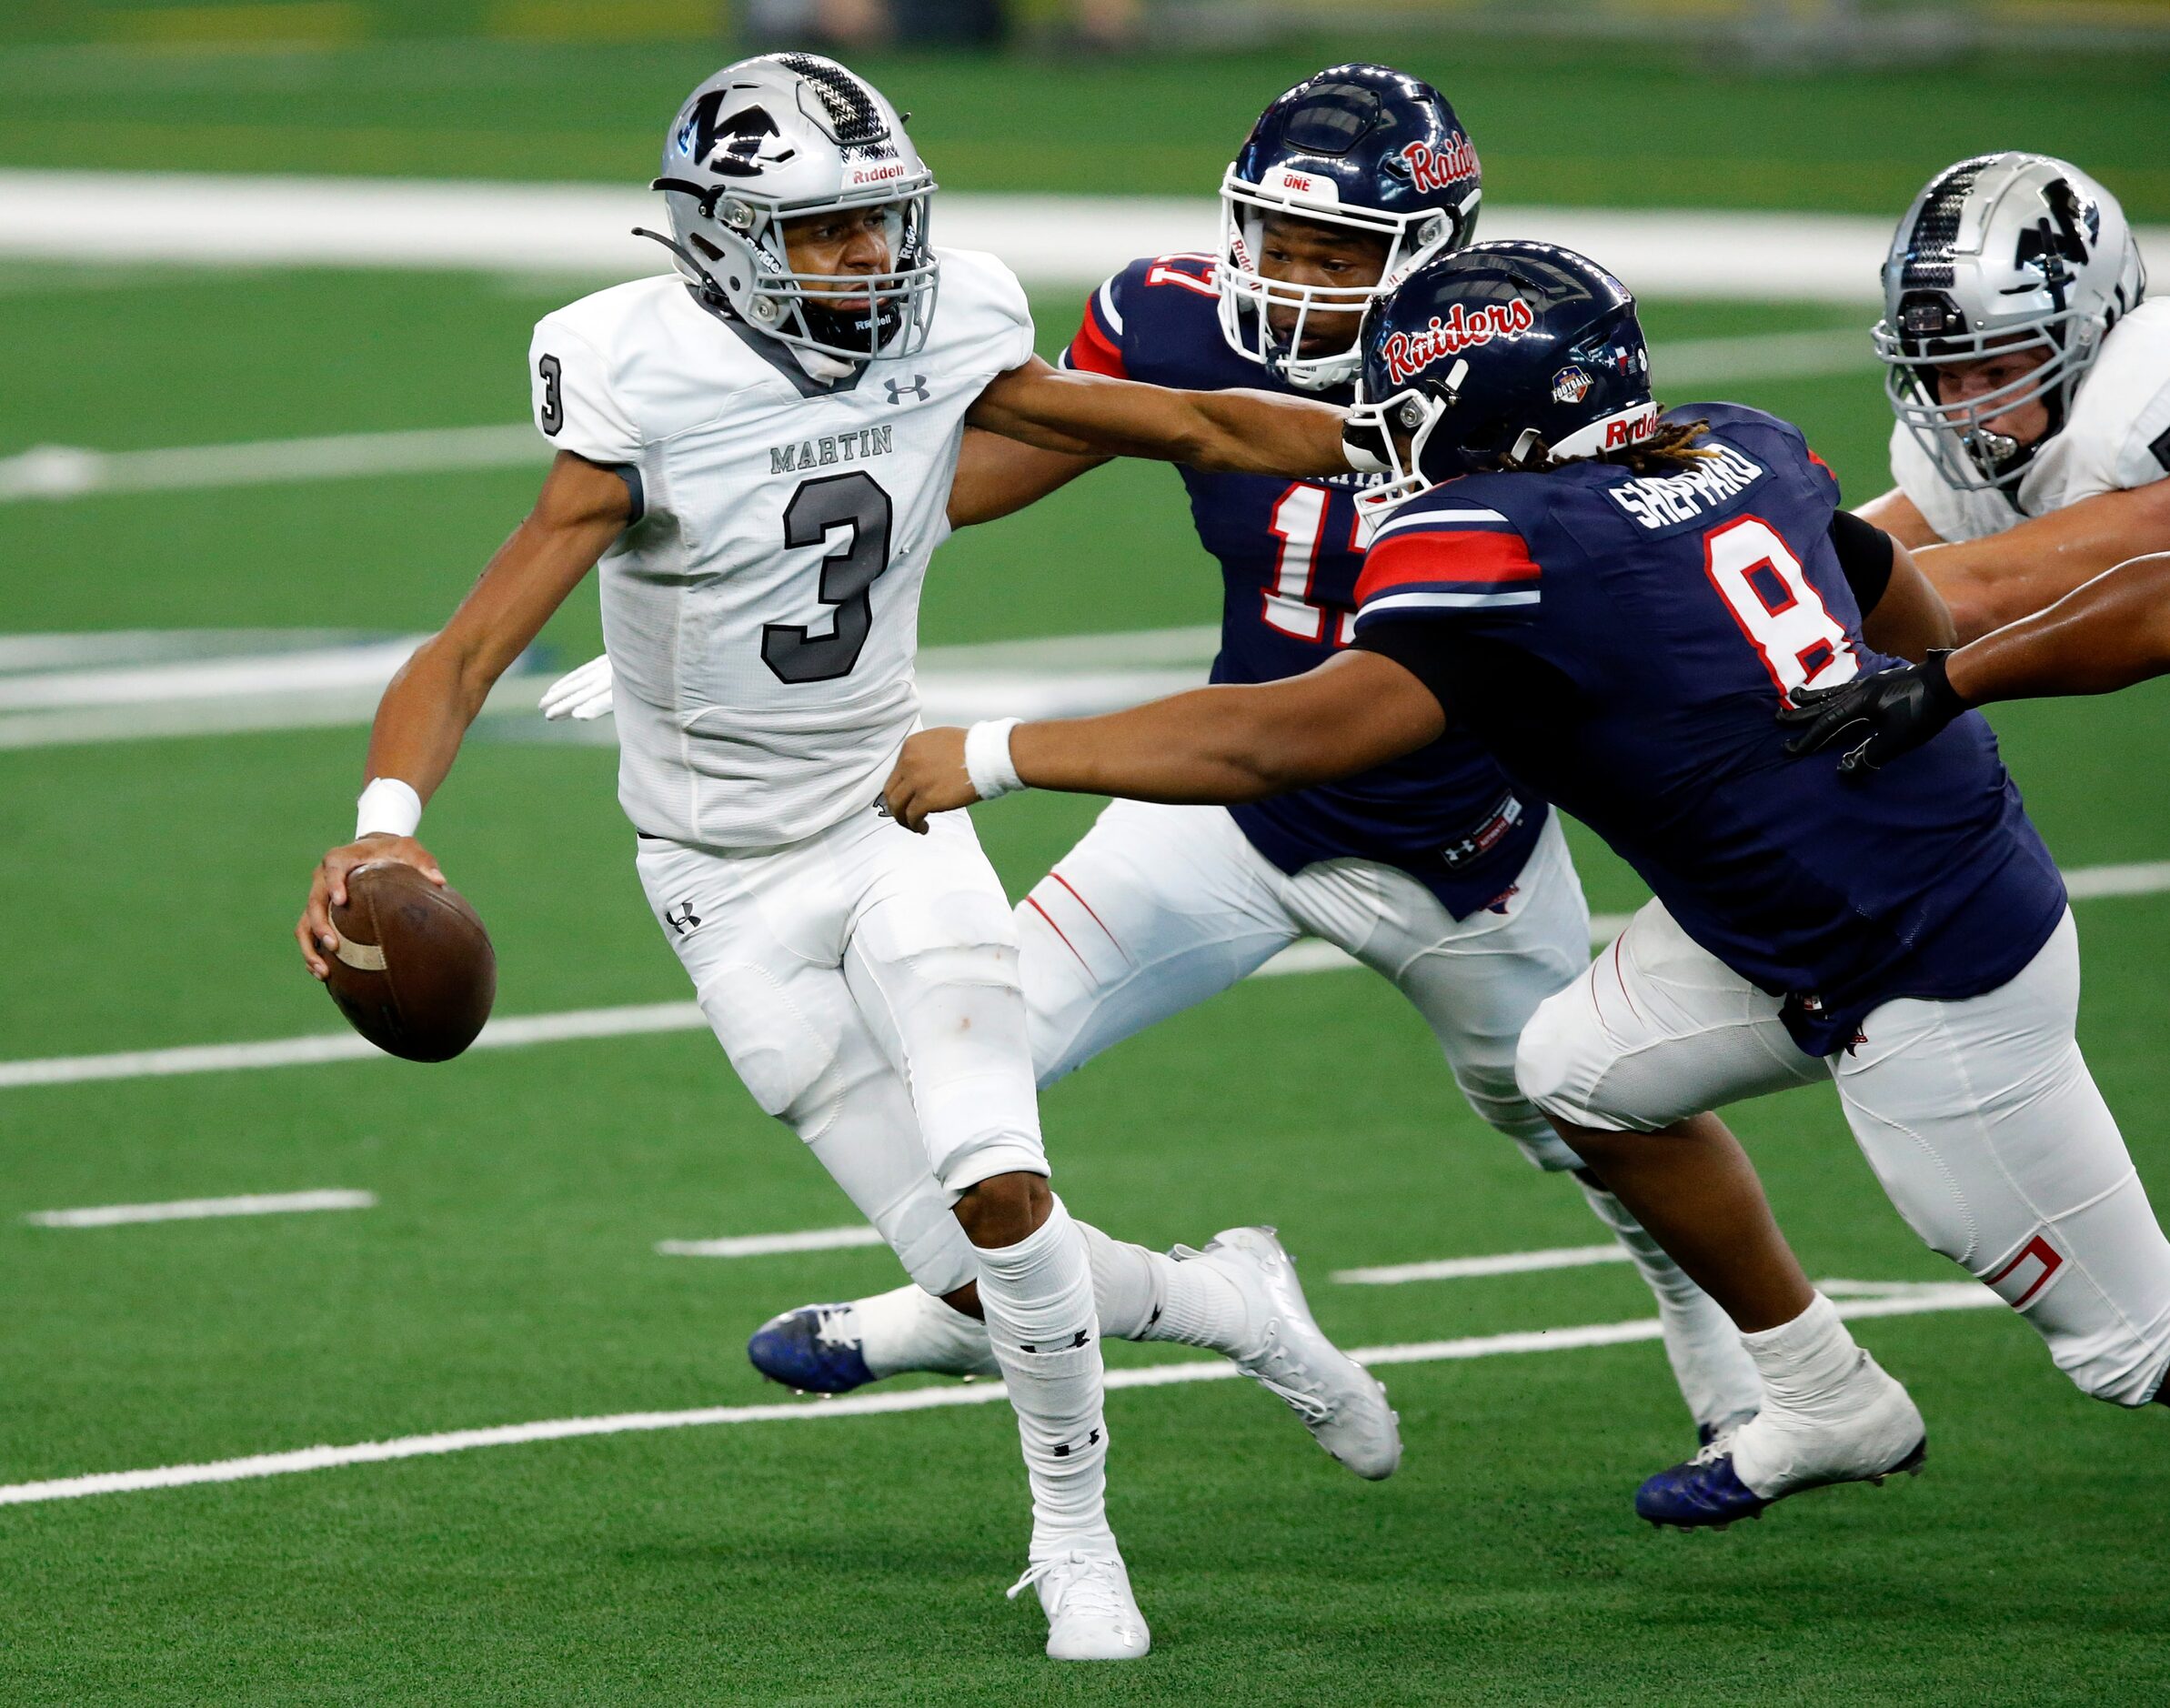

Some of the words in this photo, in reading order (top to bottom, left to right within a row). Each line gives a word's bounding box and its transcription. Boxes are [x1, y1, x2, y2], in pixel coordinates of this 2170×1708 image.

[853, 165, 905, 184] Riddell
[1283, 174, 1311, 193] ONE
[1401, 131, 1481, 194] Raide
[1231, 238, 1261, 291] Riddll
[1381, 296, 1534, 386] Raiders
[1637, 347, 1647, 372] 8
[538, 352, 564, 437] 3
[1552, 374, 1592, 402] FOOTBALL
[769, 425, 893, 475] MARTIN
[1608, 443, 1763, 529] SHEPPARD
[760, 470, 893, 685] 3
[1703, 513, 1862, 711] 8
